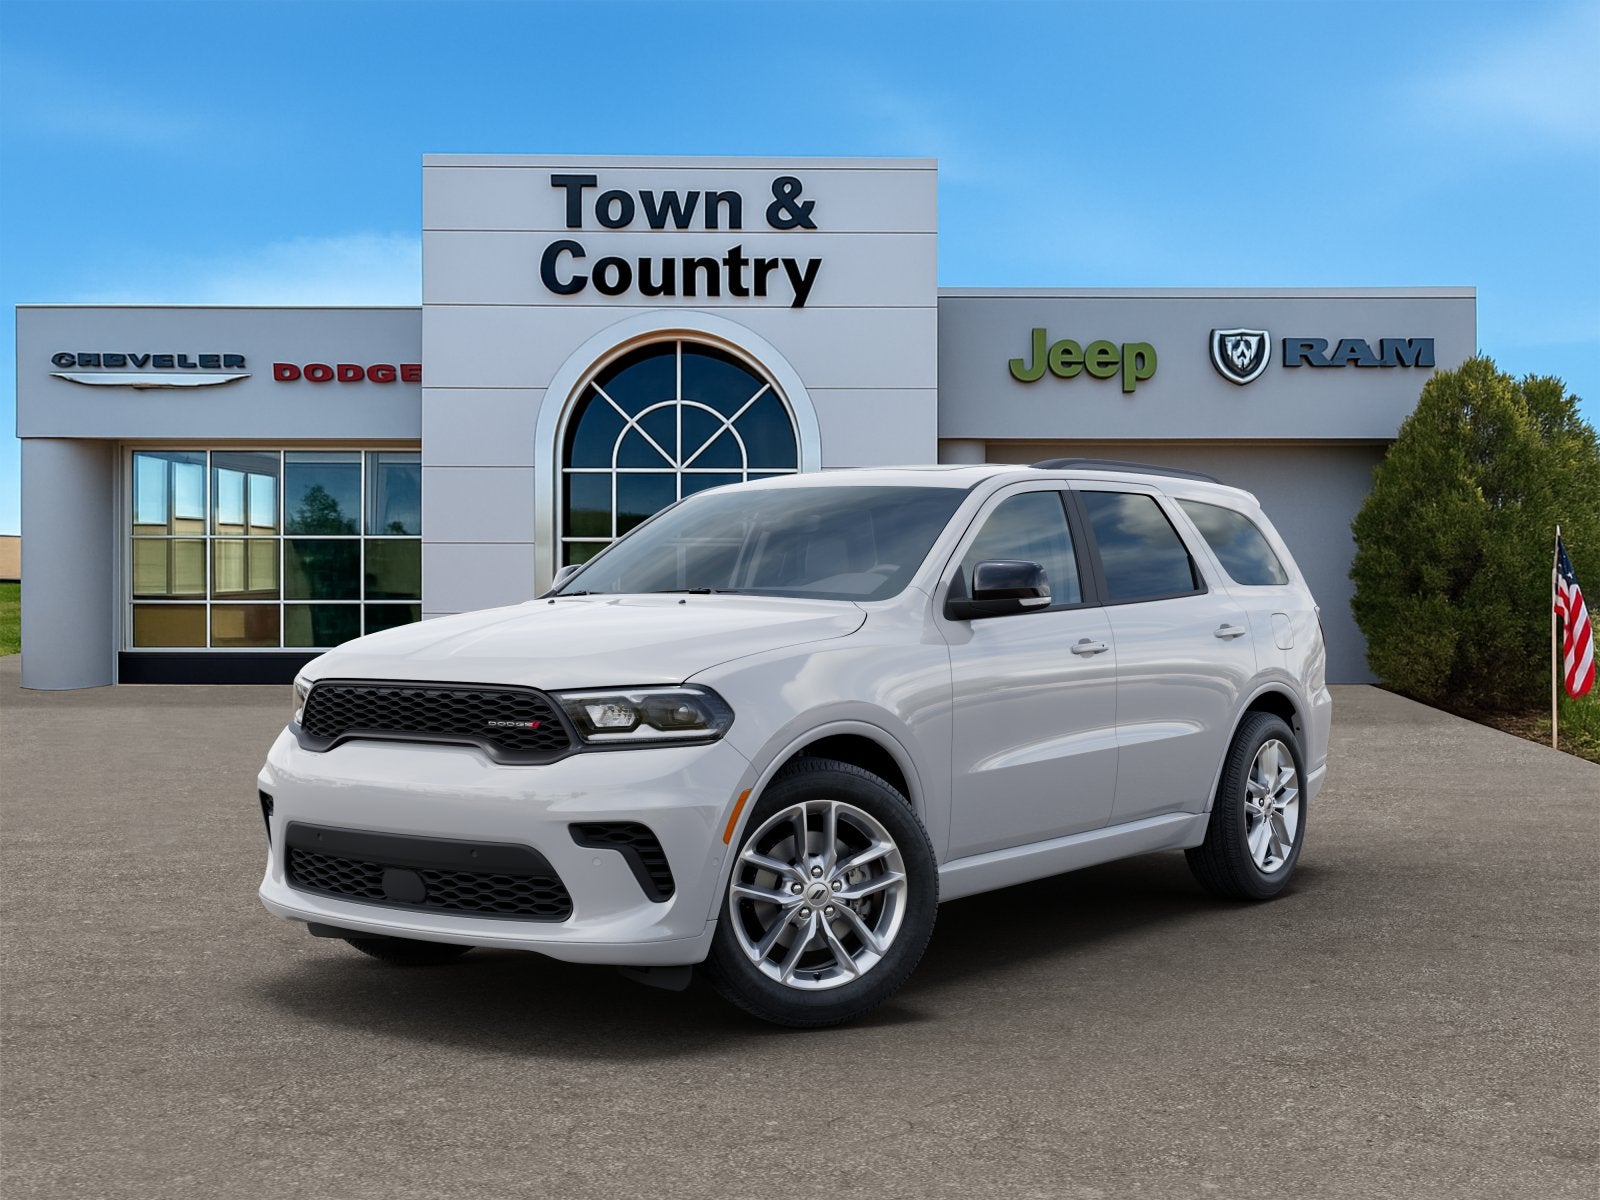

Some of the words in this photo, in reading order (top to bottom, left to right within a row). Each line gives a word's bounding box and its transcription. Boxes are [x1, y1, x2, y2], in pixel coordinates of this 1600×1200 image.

[550, 174, 742, 230] Town
[765, 175, 818, 230] &
[540, 239, 822, 308] Country
[273, 363, 422, 383] DODGE
[1009, 328, 1157, 393] Jeep
[1282, 337, 1435, 368] RAM
